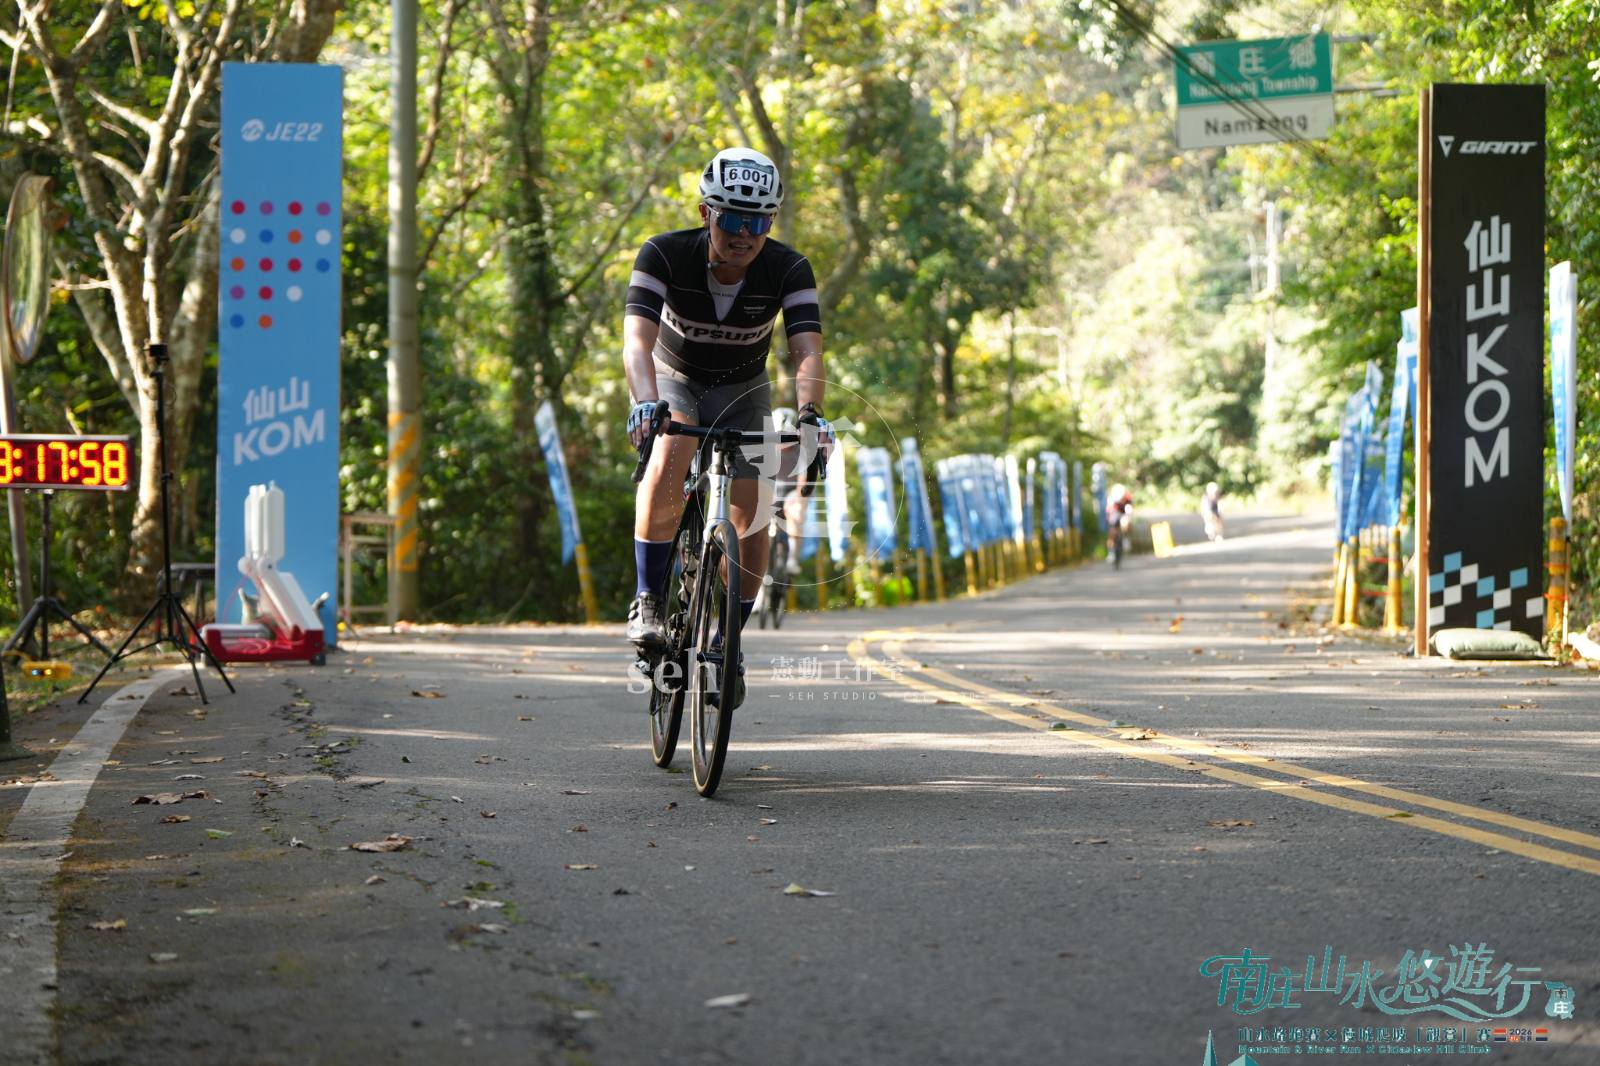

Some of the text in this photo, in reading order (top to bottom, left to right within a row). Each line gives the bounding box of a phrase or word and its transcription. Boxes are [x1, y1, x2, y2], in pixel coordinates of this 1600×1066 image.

[265, 122, 323, 142] JE22
[1459, 140, 1537, 155] GIANT
[1464, 214, 1511, 322] 仙山
[243, 376, 310, 425] 仙山
[1464, 324, 1510, 488] KOM
[233, 409, 325, 466] KOM
